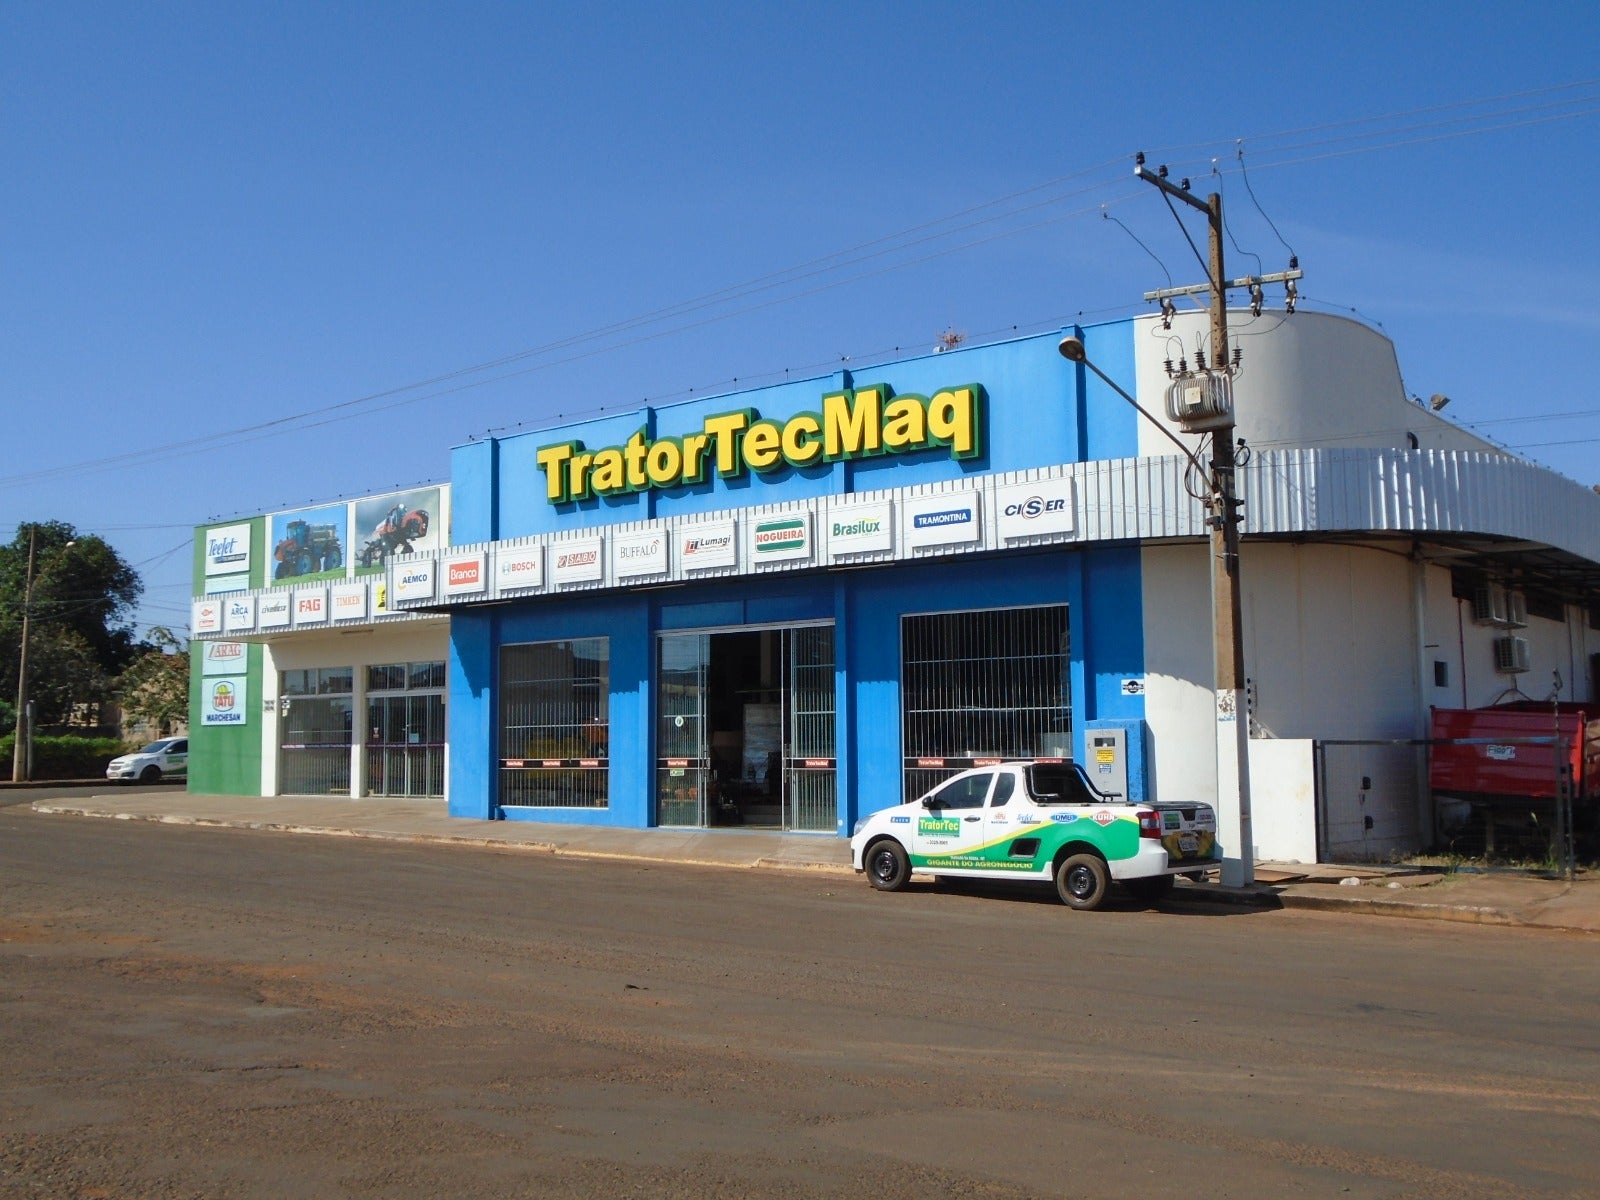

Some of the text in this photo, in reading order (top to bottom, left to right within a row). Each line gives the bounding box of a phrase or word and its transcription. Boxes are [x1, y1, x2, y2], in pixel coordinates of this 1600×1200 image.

[536, 388, 972, 499] TratorTecMaq
[1005, 498, 1065, 517] CISER
[918, 512, 968, 526] TRAMONTINA
[832, 520, 881, 537] Brasilux
[700, 534, 731, 546] Lumagi
[756, 529, 804, 543] NOGUEIRA
[620, 544, 658, 559] BUFFALO
[511, 561, 536, 572] BOSCH
[402, 573, 428, 585] AEMCO
[450, 568, 477, 581] Branco
[231, 606, 249, 616] ARCA
[299, 598, 321, 613] FAG
[213, 695, 235, 707] TATU
[206, 713, 241, 722] MARCHESAN
[919, 819, 959, 831] TratorTec
[926, 859, 960, 867] GIGANTE
